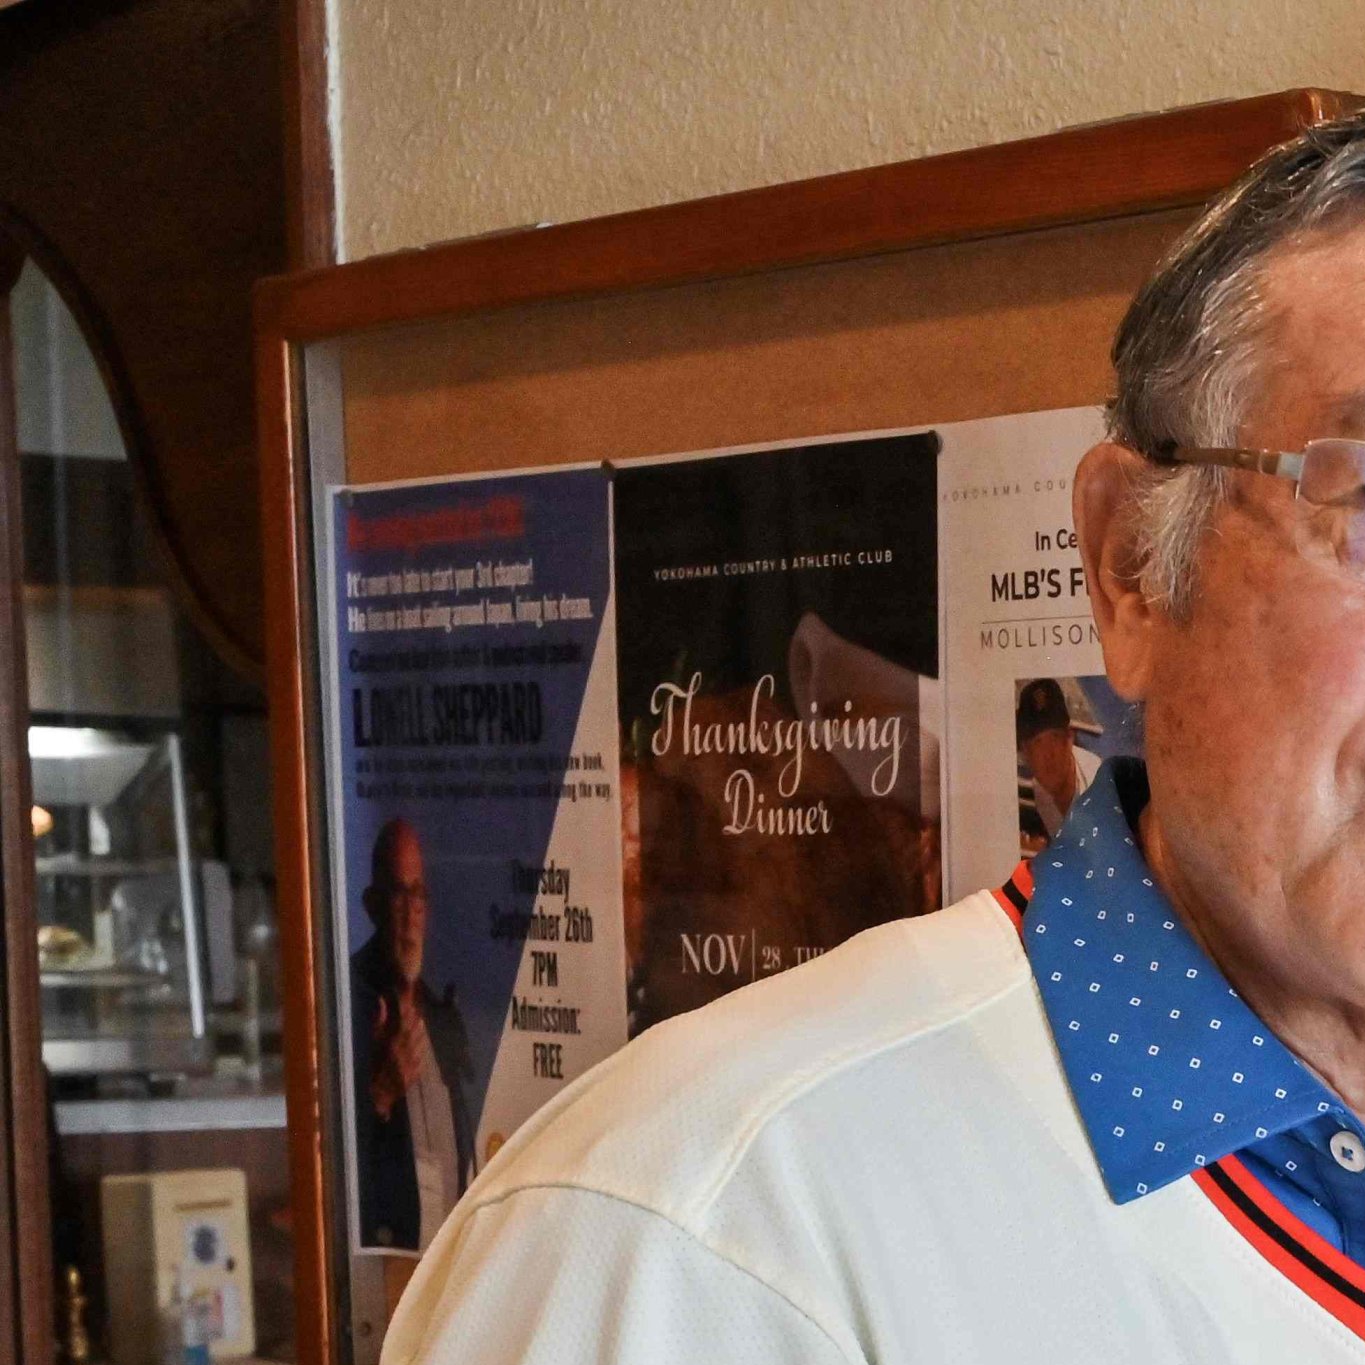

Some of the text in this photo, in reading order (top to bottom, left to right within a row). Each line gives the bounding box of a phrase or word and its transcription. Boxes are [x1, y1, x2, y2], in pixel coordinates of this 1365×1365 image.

[1035, 531, 1050, 550] In
[654, 550, 893, 581] YOKOHAMA COUNTRY & ATHLETIC CLUB
[991, 569, 1061, 602] MLB'S
[981, 624, 1101, 649] MOLLISON
[649, 671, 908, 797] Thanksgiving
[722, 769, 833, 836] Dinner
[564, 905, 594, 944] 26th
[531, 950, 559, 988] 7PM
[681, 933, 745, 975] NOV
[511, 996, 582, 1036] Admission:
[533, 1042, 564, 1081] FREE
